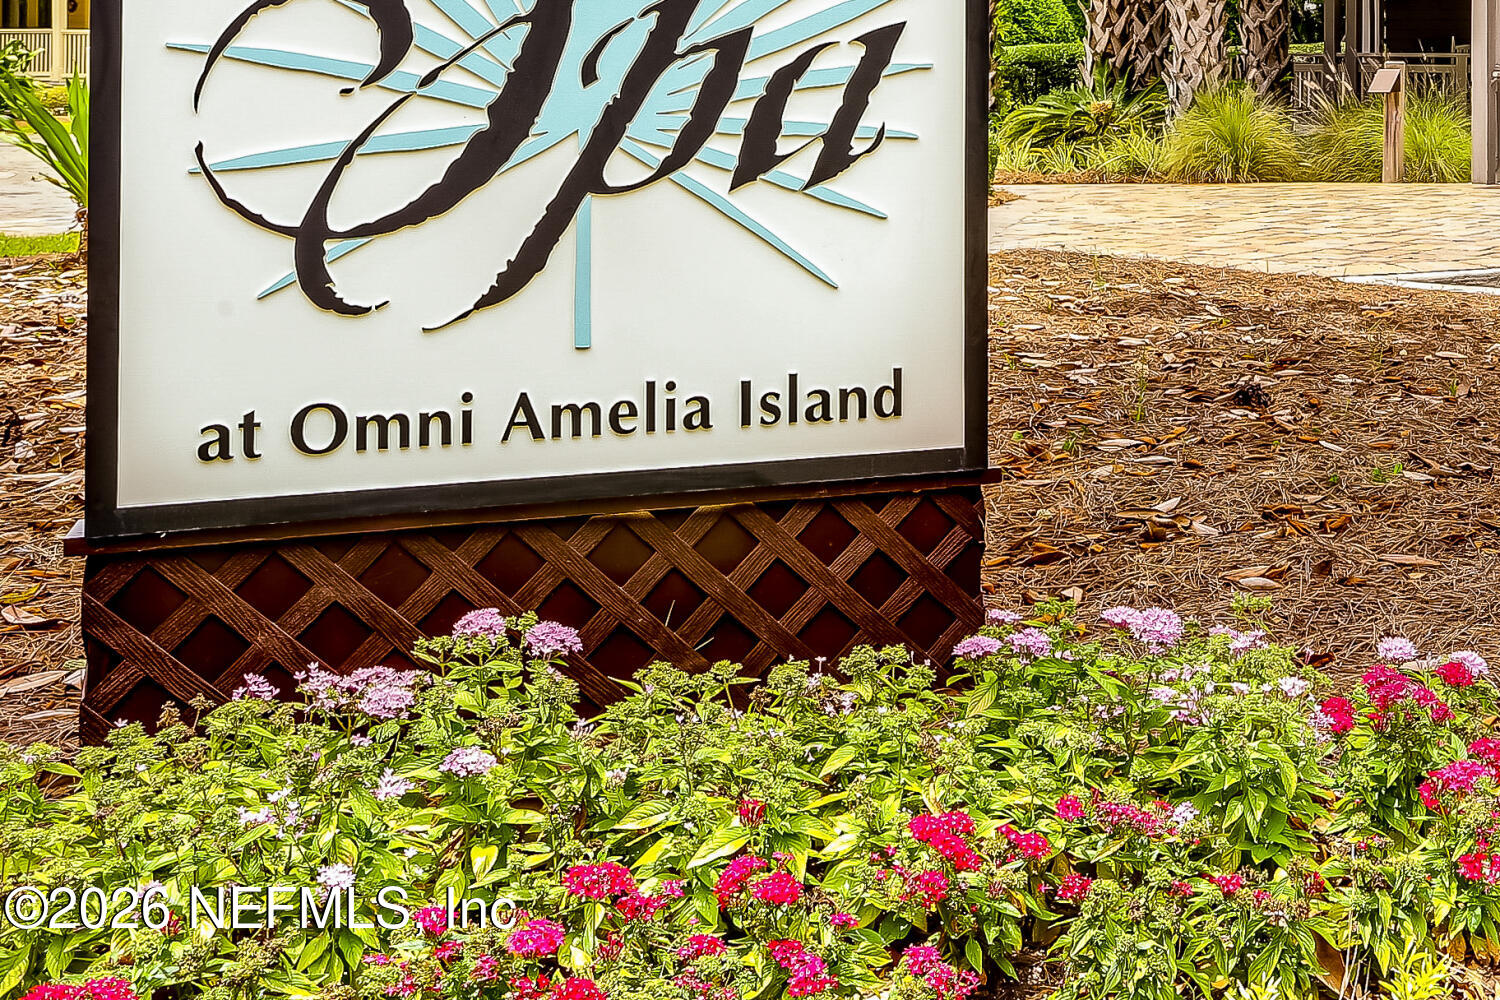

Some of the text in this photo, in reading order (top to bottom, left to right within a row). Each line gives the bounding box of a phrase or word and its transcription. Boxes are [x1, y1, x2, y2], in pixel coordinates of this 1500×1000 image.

[197, 367, 904, 463] at Omni Amelia Island
